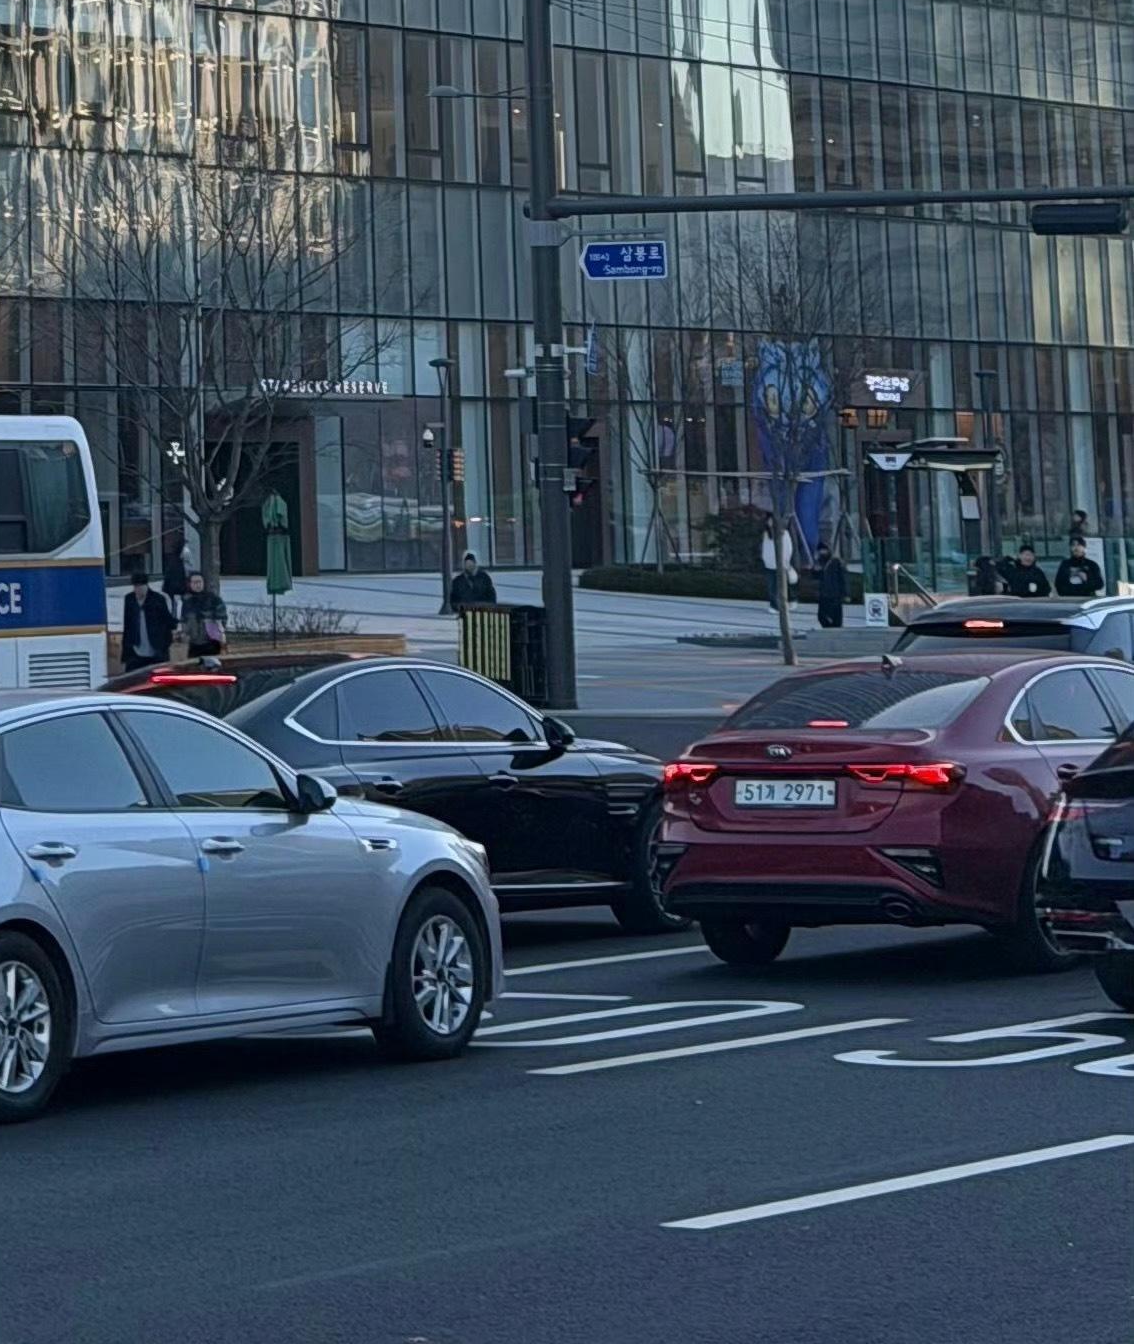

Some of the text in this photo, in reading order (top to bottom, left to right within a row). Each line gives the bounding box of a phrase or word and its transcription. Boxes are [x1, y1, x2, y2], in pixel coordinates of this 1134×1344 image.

[620, 246, 662, 262] 삼봉로
[335, 380, 388, 395] RESERVE
[784, 783, 824, 801] 2971
